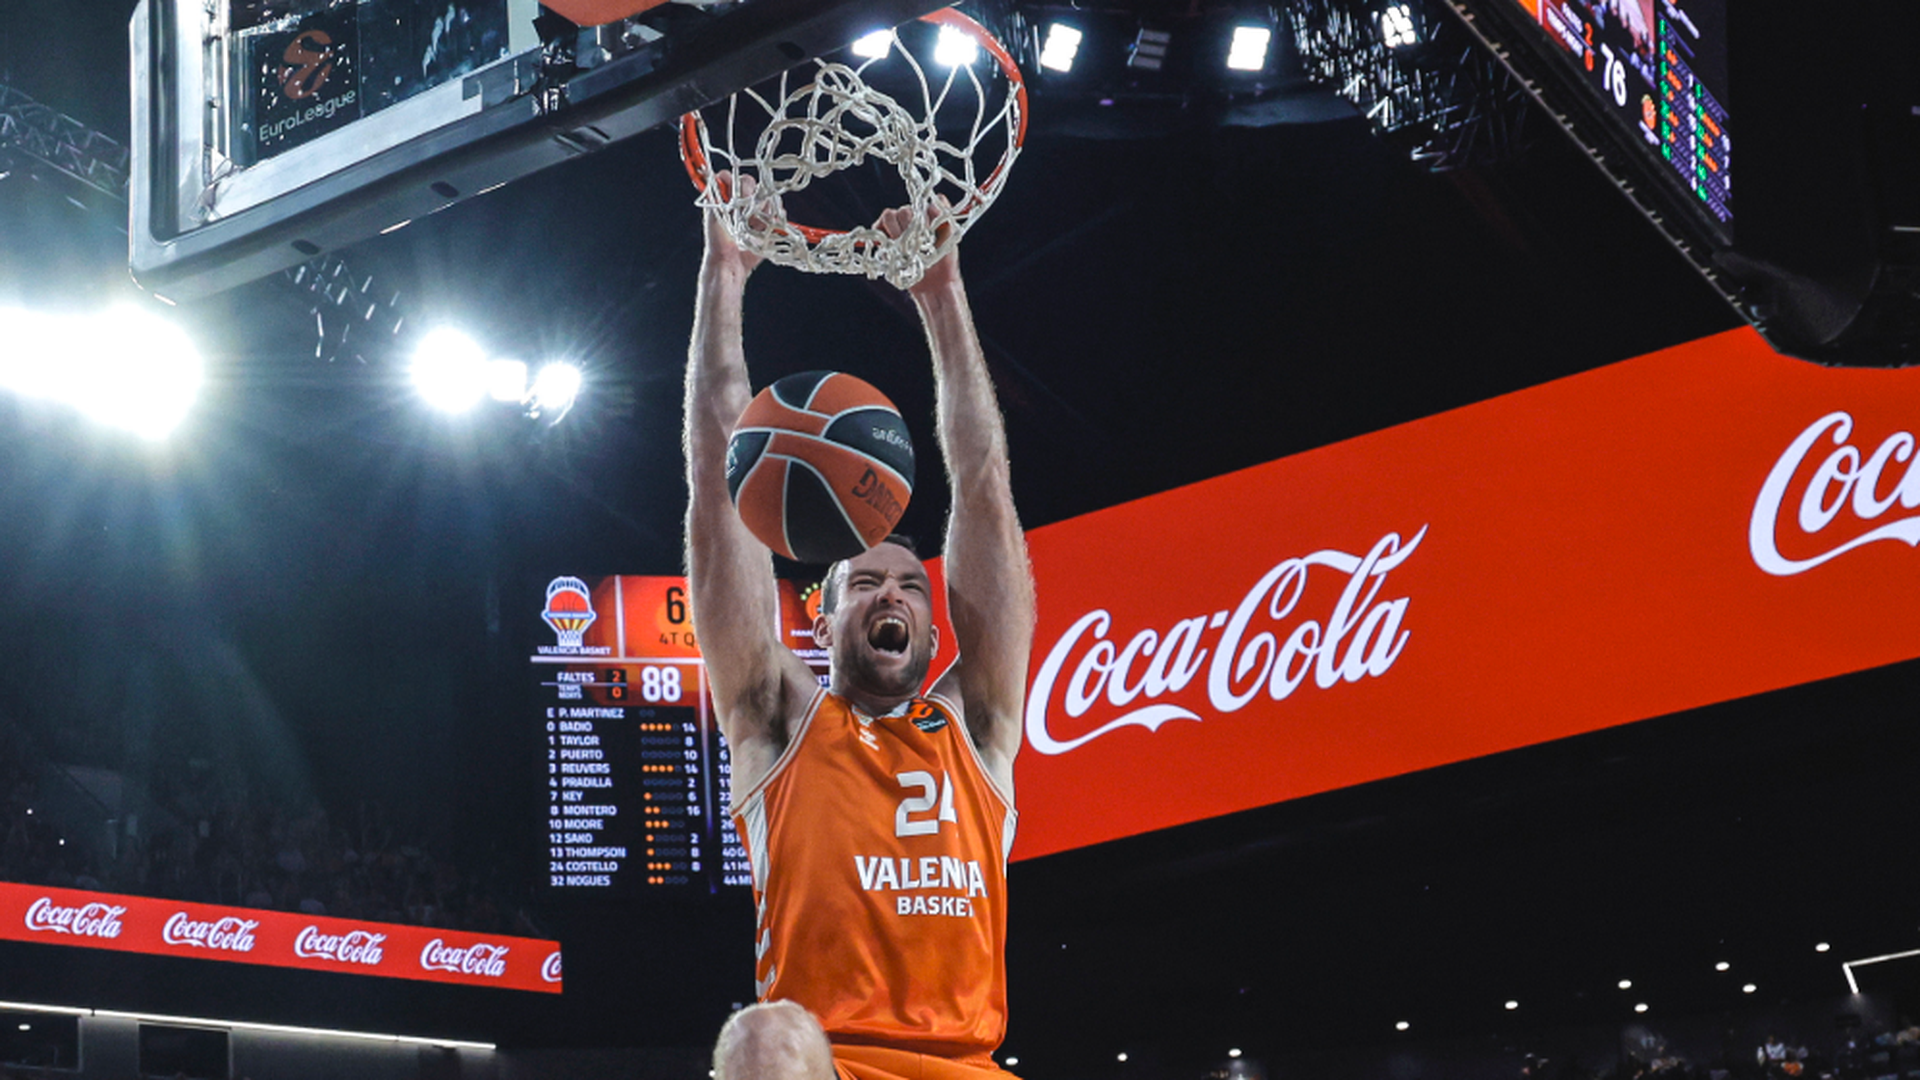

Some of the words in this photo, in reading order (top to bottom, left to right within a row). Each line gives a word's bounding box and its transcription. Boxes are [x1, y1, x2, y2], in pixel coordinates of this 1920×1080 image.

[259, 90, 356, 141] EuroLeague
[666, 586, 685, 625] 6
[1025, 523, 1429, 755] Coca-Cola
[557, 671, 595, 683] FALTES
[612, 670, 621, 682] 2
[641, 665, 682, 702] 88
[612, 686, 621, 698] 0
[546, 707, 555, 718] E
[546, 721, 555, 732] 0
[559, 721, 593, 732] BADIO
[682, 722, 697, 732] 14
[548, 735, 555, 745] 1
[559, 735, 600, 746] TAYLOR
[548, 749, 556, 760] 2
[560, 749, 604, 760] PUERTO
[684, 749, 698, 760] 10
[719, 749, 729, 760] 6
[561, 763, 610, 774] REUVERS
[684, 764, 699, 774] 14
[549, 777, 558, 787] 4
[562, 777, 613, 788] PRADILLA
[687, 777, 697, 788] 2
[550, 790, 558, 801] 7
[562, 791, 583, 801] KEY
[562, 804, 618, 816] MONTERO
[686, 805, 701, 816] 16
[549, 819, 562, 829] 10
[564, 819, 604, 830] MOORE
[549, 833, 562, 844] 12
[564, 833, 593, 844] SAKO
[690, 832, 699, 844] 2
[549, 847, 563, 858] 13
[565, 847, 627, 858] THOMPSON
[550, 861, 564, 871] 24
[565, 861, 619, 872] COSTELLO
[550, 875, 565, 886] 32
[566, 875, 611, 886] NOGUES
[25, 897, 127, 938] Coca-Cola
[162, 912, 259, 952] Coca-Cola
[294, 925, 387, 965] Coca-Cola
[420, 938, 509, 977] Coca-Cola
